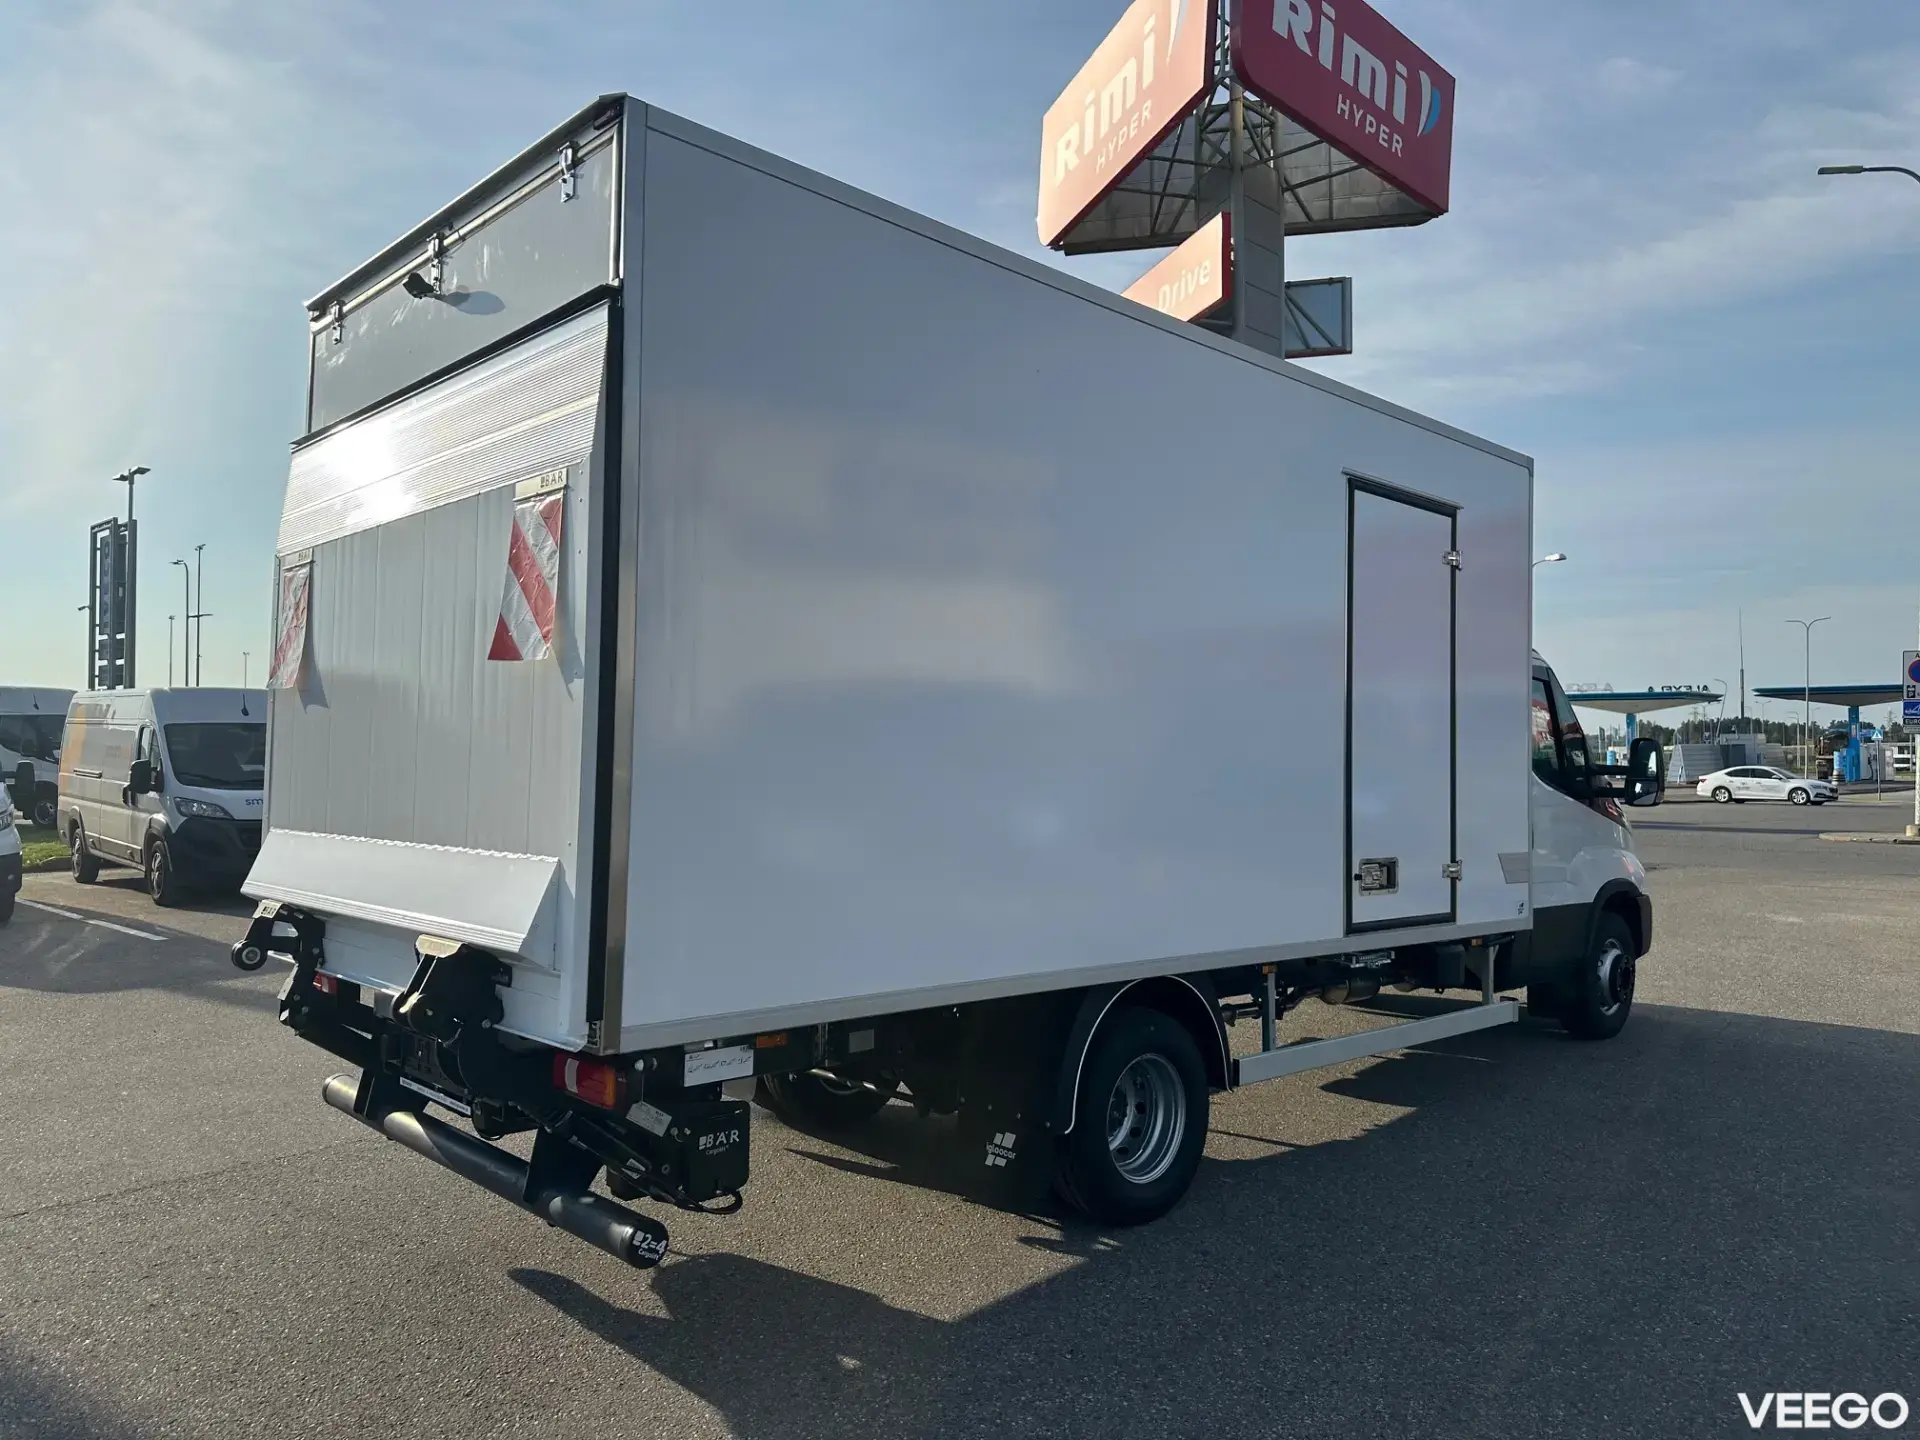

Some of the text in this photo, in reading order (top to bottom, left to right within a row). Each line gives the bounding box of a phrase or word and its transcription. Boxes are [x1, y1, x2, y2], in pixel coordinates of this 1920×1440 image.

[1272, 0, 1408, 125] Rimi
[1055, 14, 1156, 187] Rimi
[1337, 93, 1404, 157] HYPER
[1095, 99, 1152, 174] HYPER
[1158, 259, 1212, 312] Drive
[705, 1129, 740, 1149] BÄR
[985, 1141, 1016, 1160] igloocar
